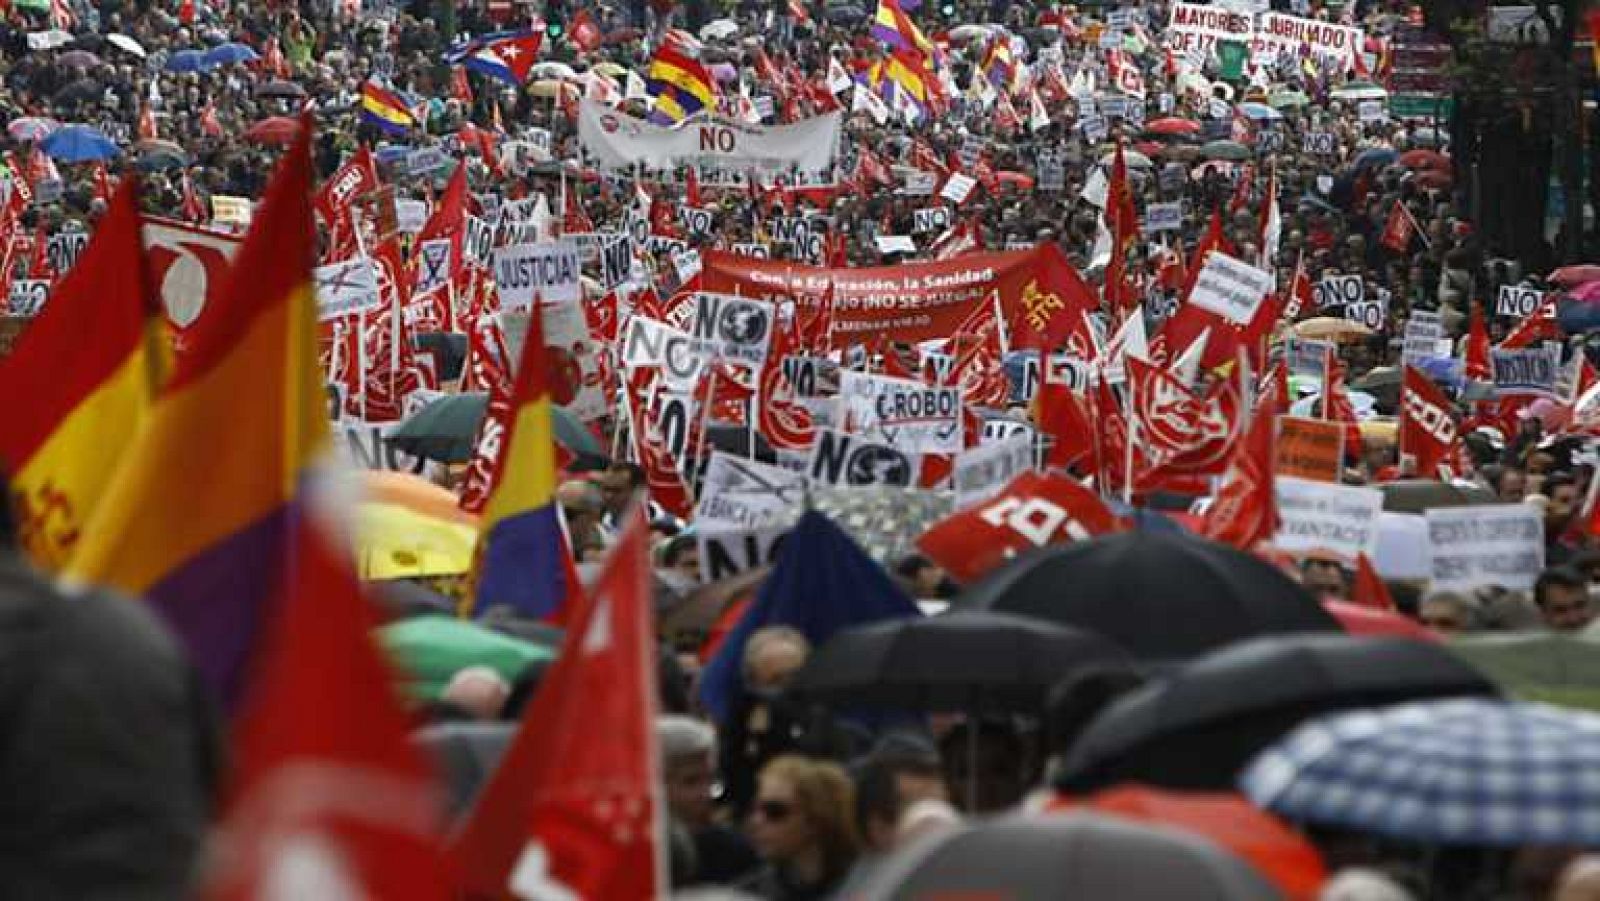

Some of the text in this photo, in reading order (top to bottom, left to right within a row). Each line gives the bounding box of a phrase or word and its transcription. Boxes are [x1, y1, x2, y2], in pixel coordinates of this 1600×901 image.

[699, 126, 736, 152] NO
[606, 238, 630, 285] NO
[924, 270, 994, 289] Sanidad
[1325, 278, 1361, 304] NO
[1501, 287, 1538, 316] NO
[1348, 302, 1380, 328] NO
